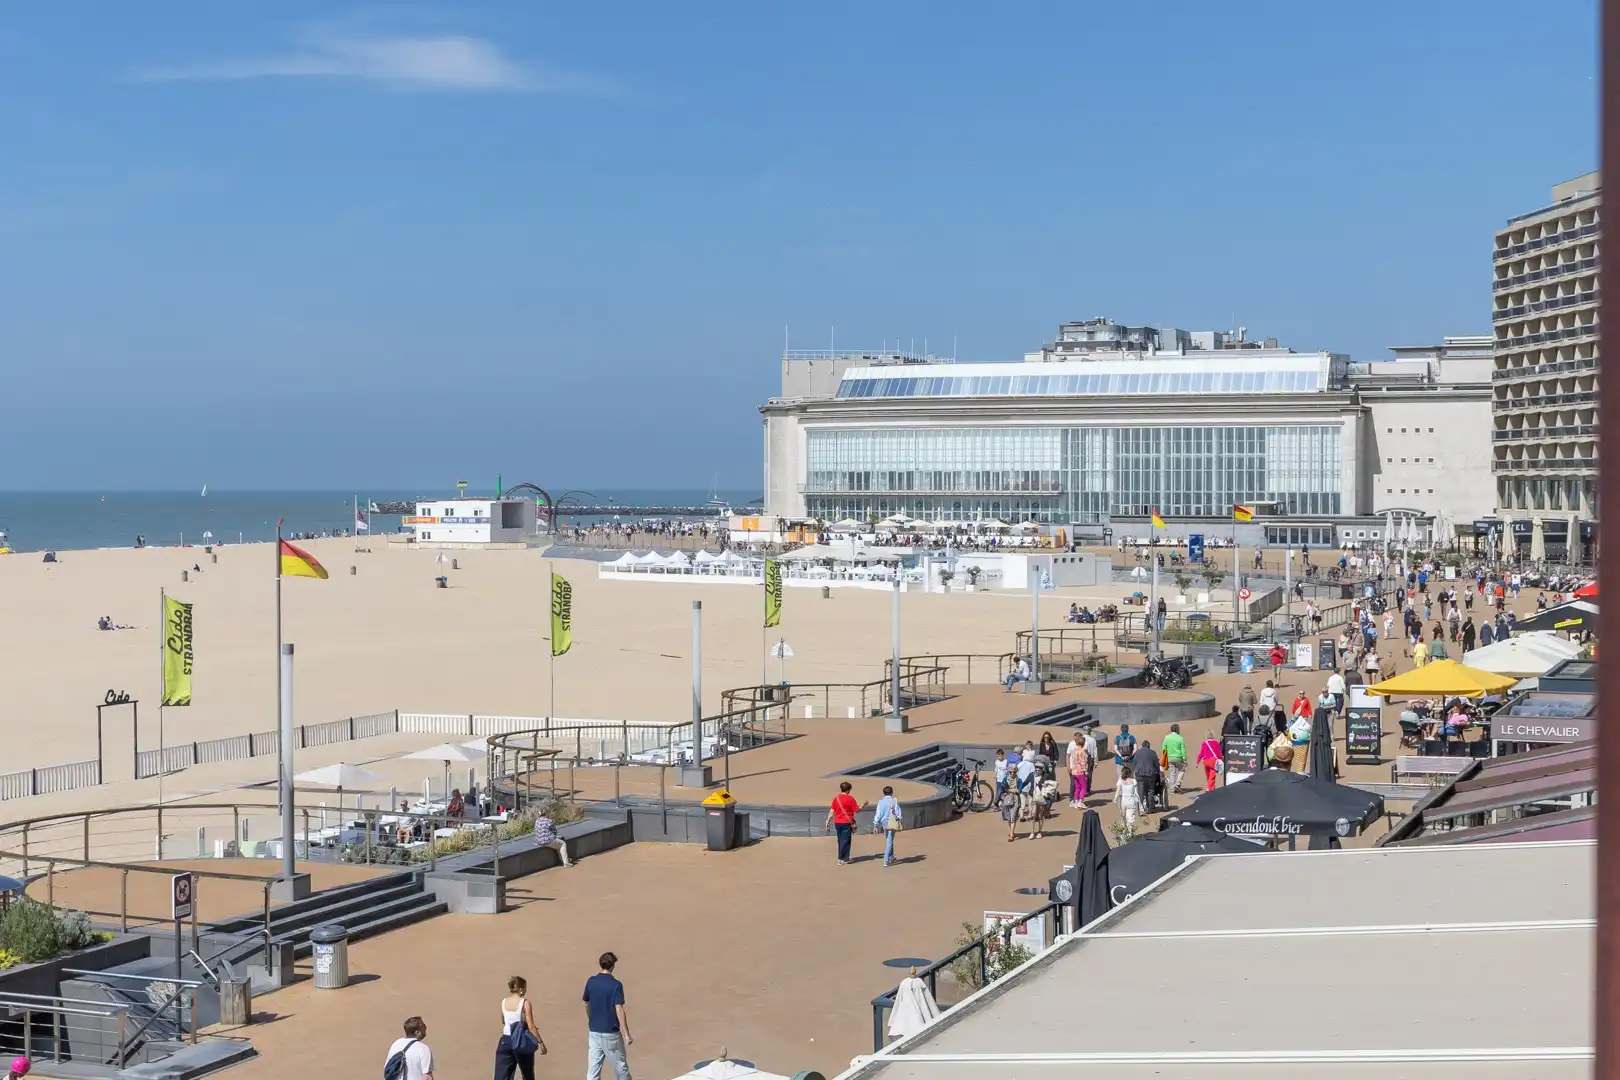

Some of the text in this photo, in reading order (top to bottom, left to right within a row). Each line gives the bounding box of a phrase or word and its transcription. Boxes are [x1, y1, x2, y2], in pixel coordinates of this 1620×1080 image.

[1298, 645, 1311, 653] WC
[1501, 724, 1580, 737] LE CHEVALIER
[1212, 815, 1305, 834] Corsendonk bier
